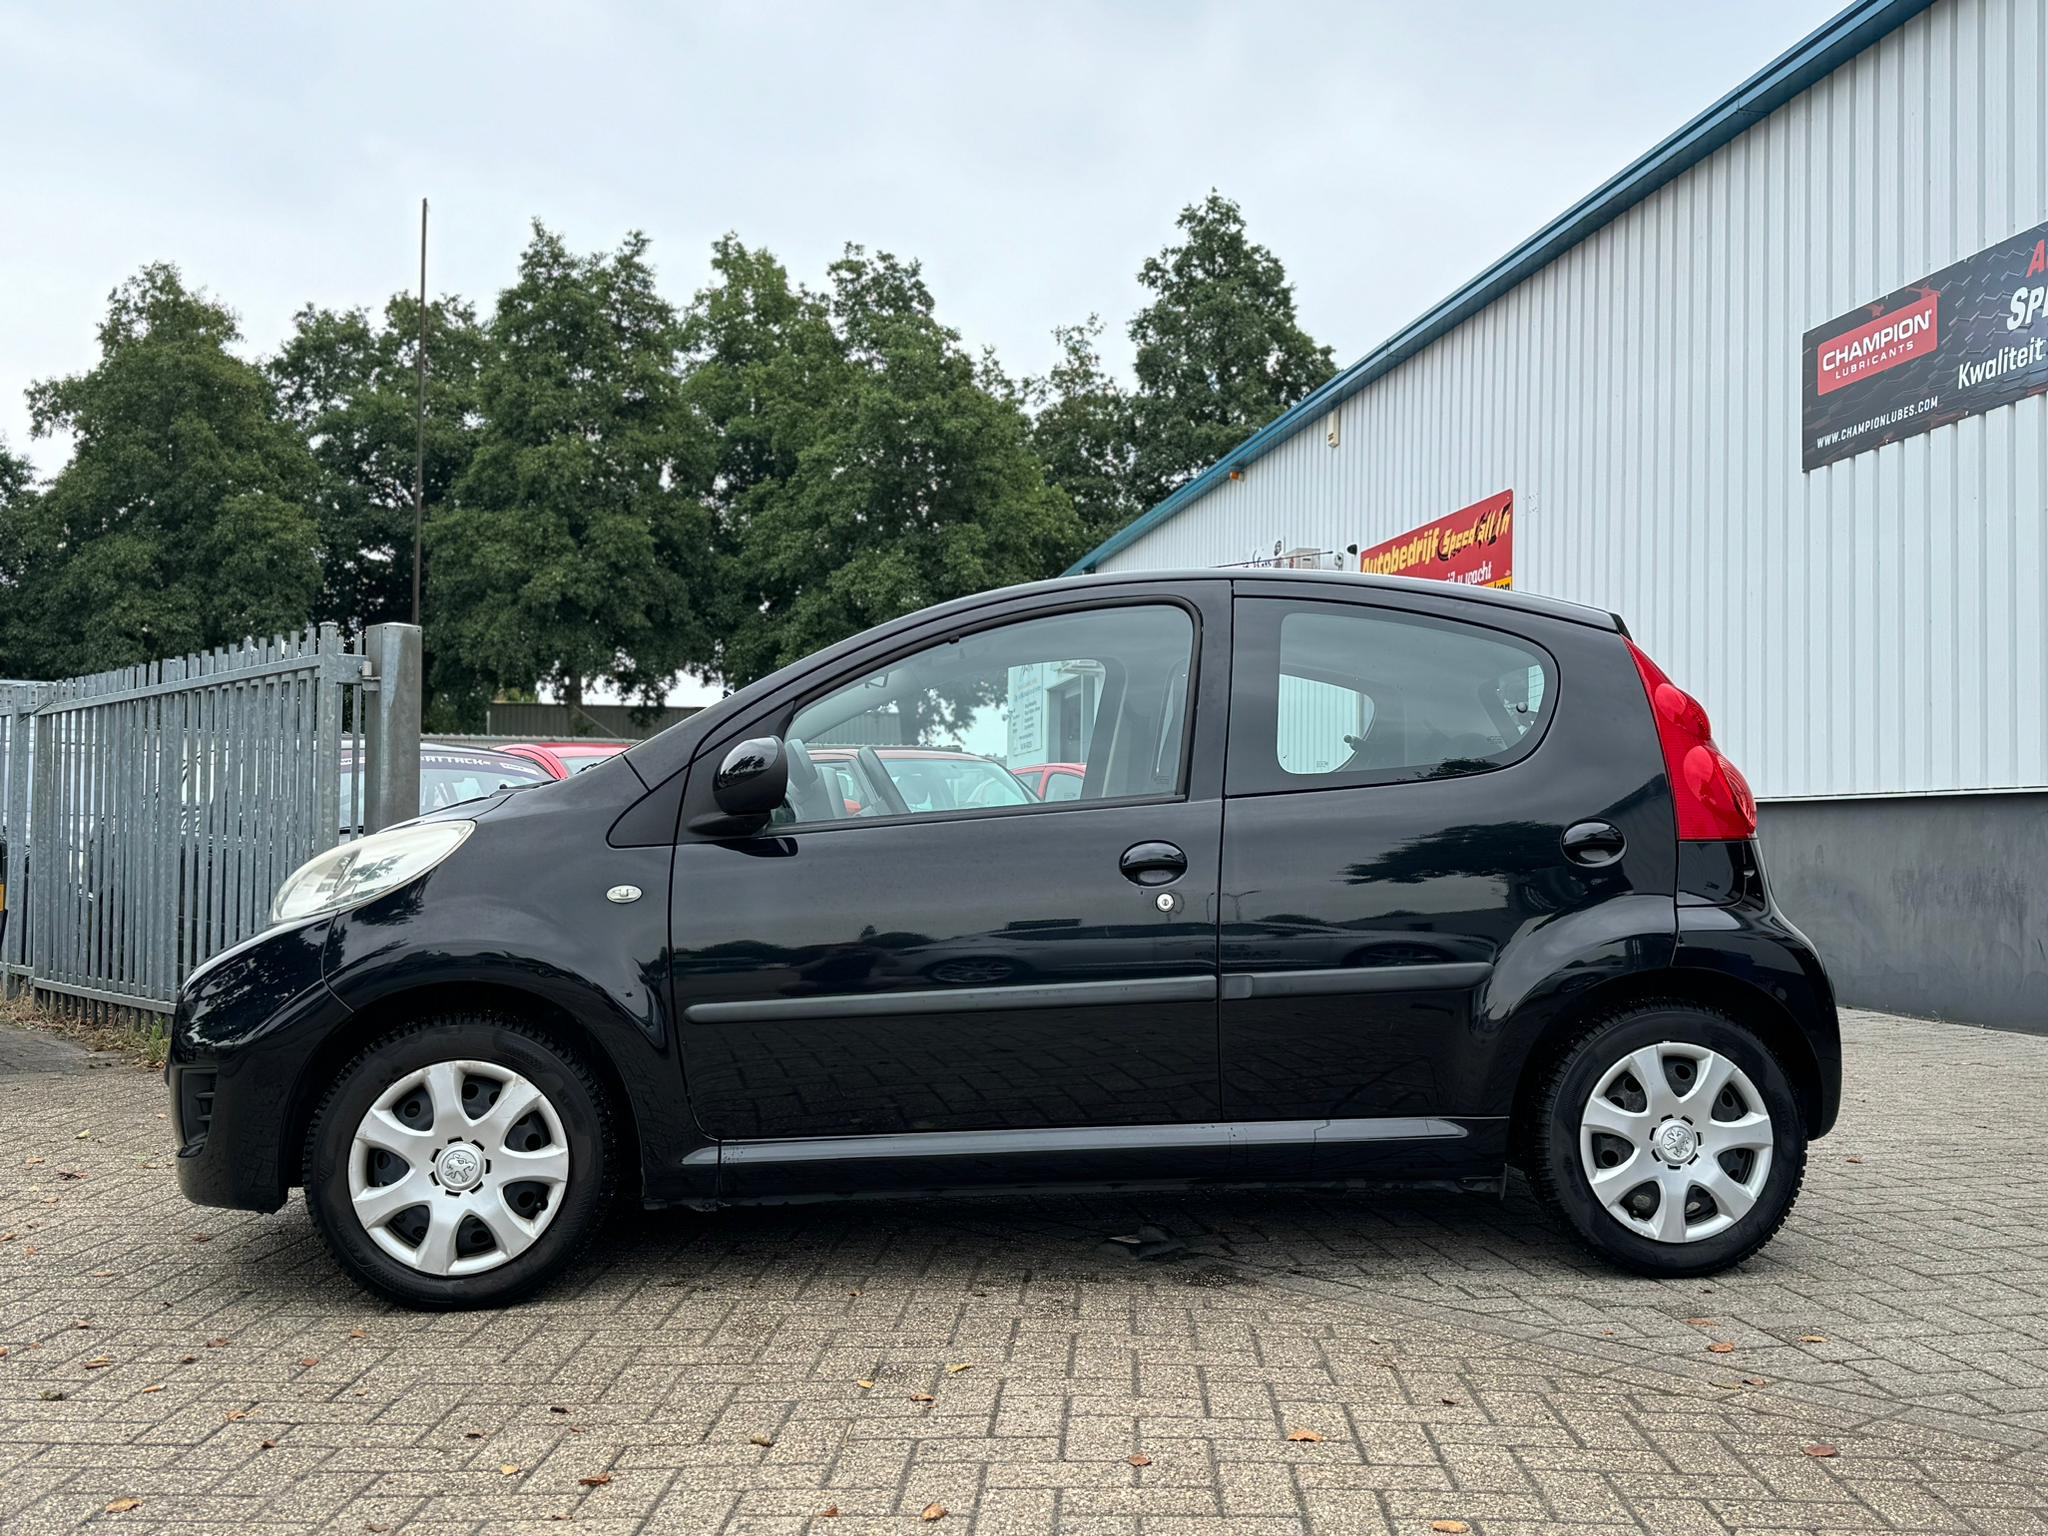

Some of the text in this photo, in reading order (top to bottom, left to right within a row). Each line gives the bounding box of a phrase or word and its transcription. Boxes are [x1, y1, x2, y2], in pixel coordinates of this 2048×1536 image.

[2026, 239, 2048, 278] A
[1822, 313, 1930, 371] CHAMPION
[1835, 340, 1914, 380] LUBRICANTS
[1958, 337, 2046, 390] Kwaliteit
[1816, 395, 1939, 449] WWW.CHAMPIONLUBES.COM
[1362, 527, 1440, 574] Autobedrijf
